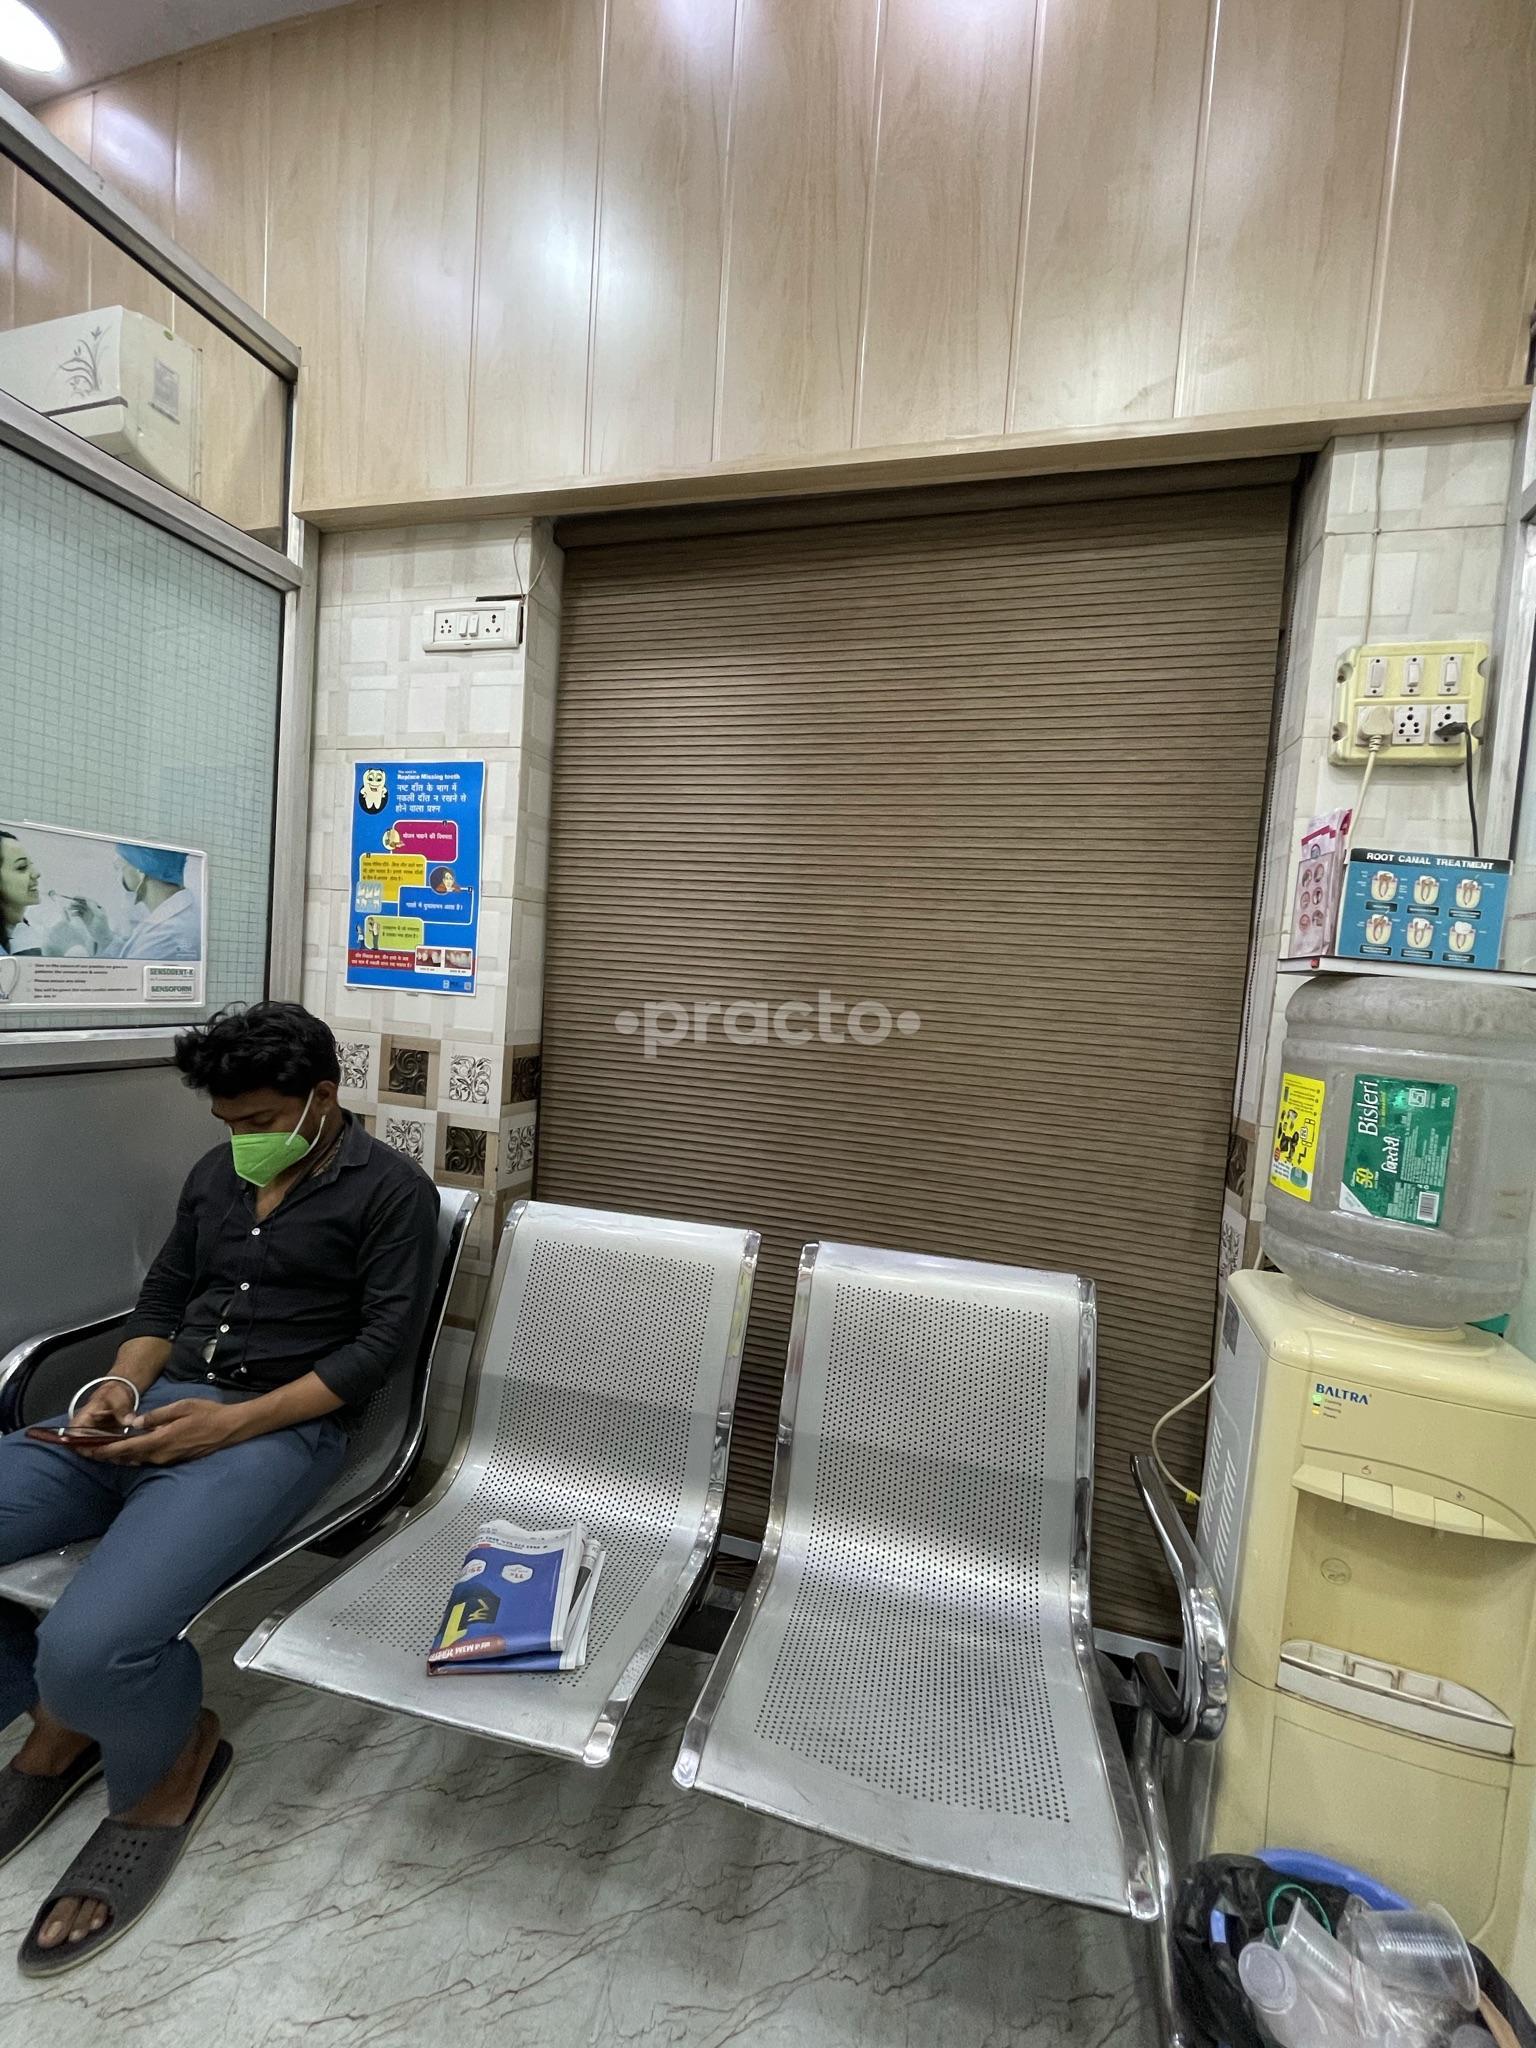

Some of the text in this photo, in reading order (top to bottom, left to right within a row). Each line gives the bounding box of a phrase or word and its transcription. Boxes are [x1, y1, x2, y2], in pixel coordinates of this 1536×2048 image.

[1366, 852, 1495, 870] ROOT CANAL TREATMENT
[1357, 1080, 1378, 1136] Bisleri
[1355, 1167, 1374, 1189] 50
[1315, 1383, 1369, 1405] BALTRA
